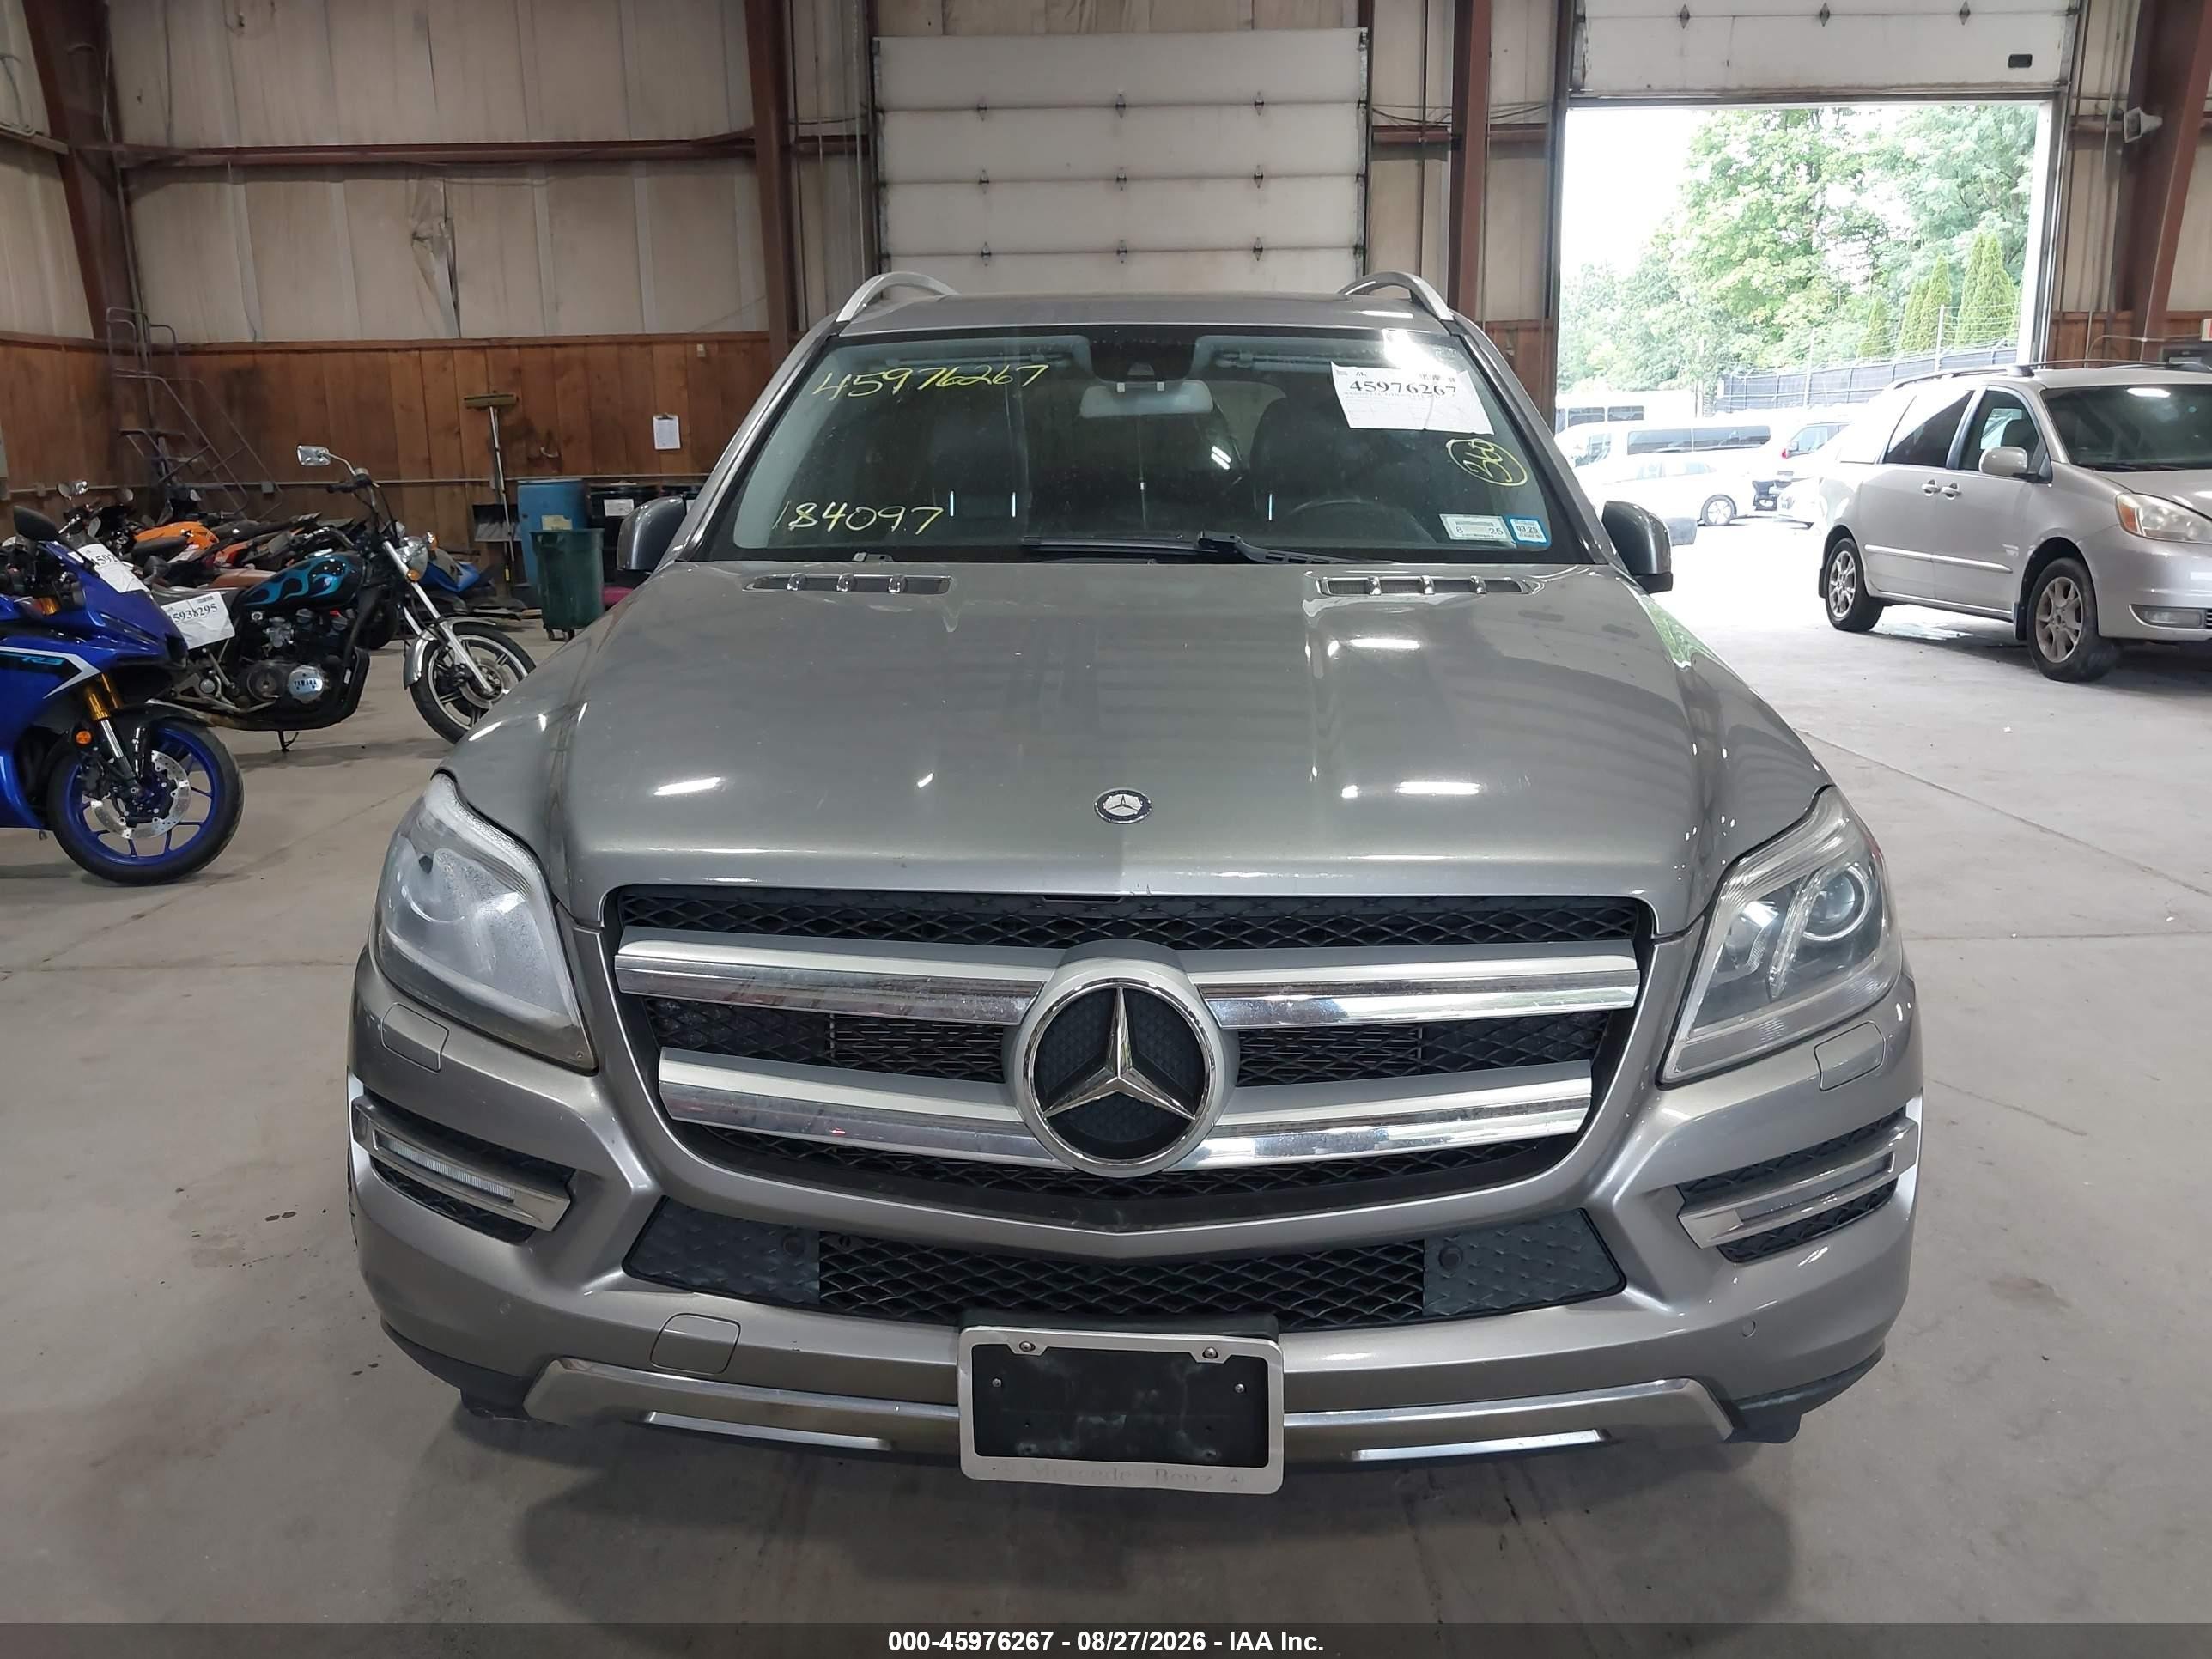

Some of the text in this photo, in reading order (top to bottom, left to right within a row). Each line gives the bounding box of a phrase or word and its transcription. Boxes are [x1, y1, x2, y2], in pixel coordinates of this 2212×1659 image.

[1349, 380, 1457, 397] 45976267
[771, 500, 945, 535] 184097
[170, 603, 218, 624] 5938295
